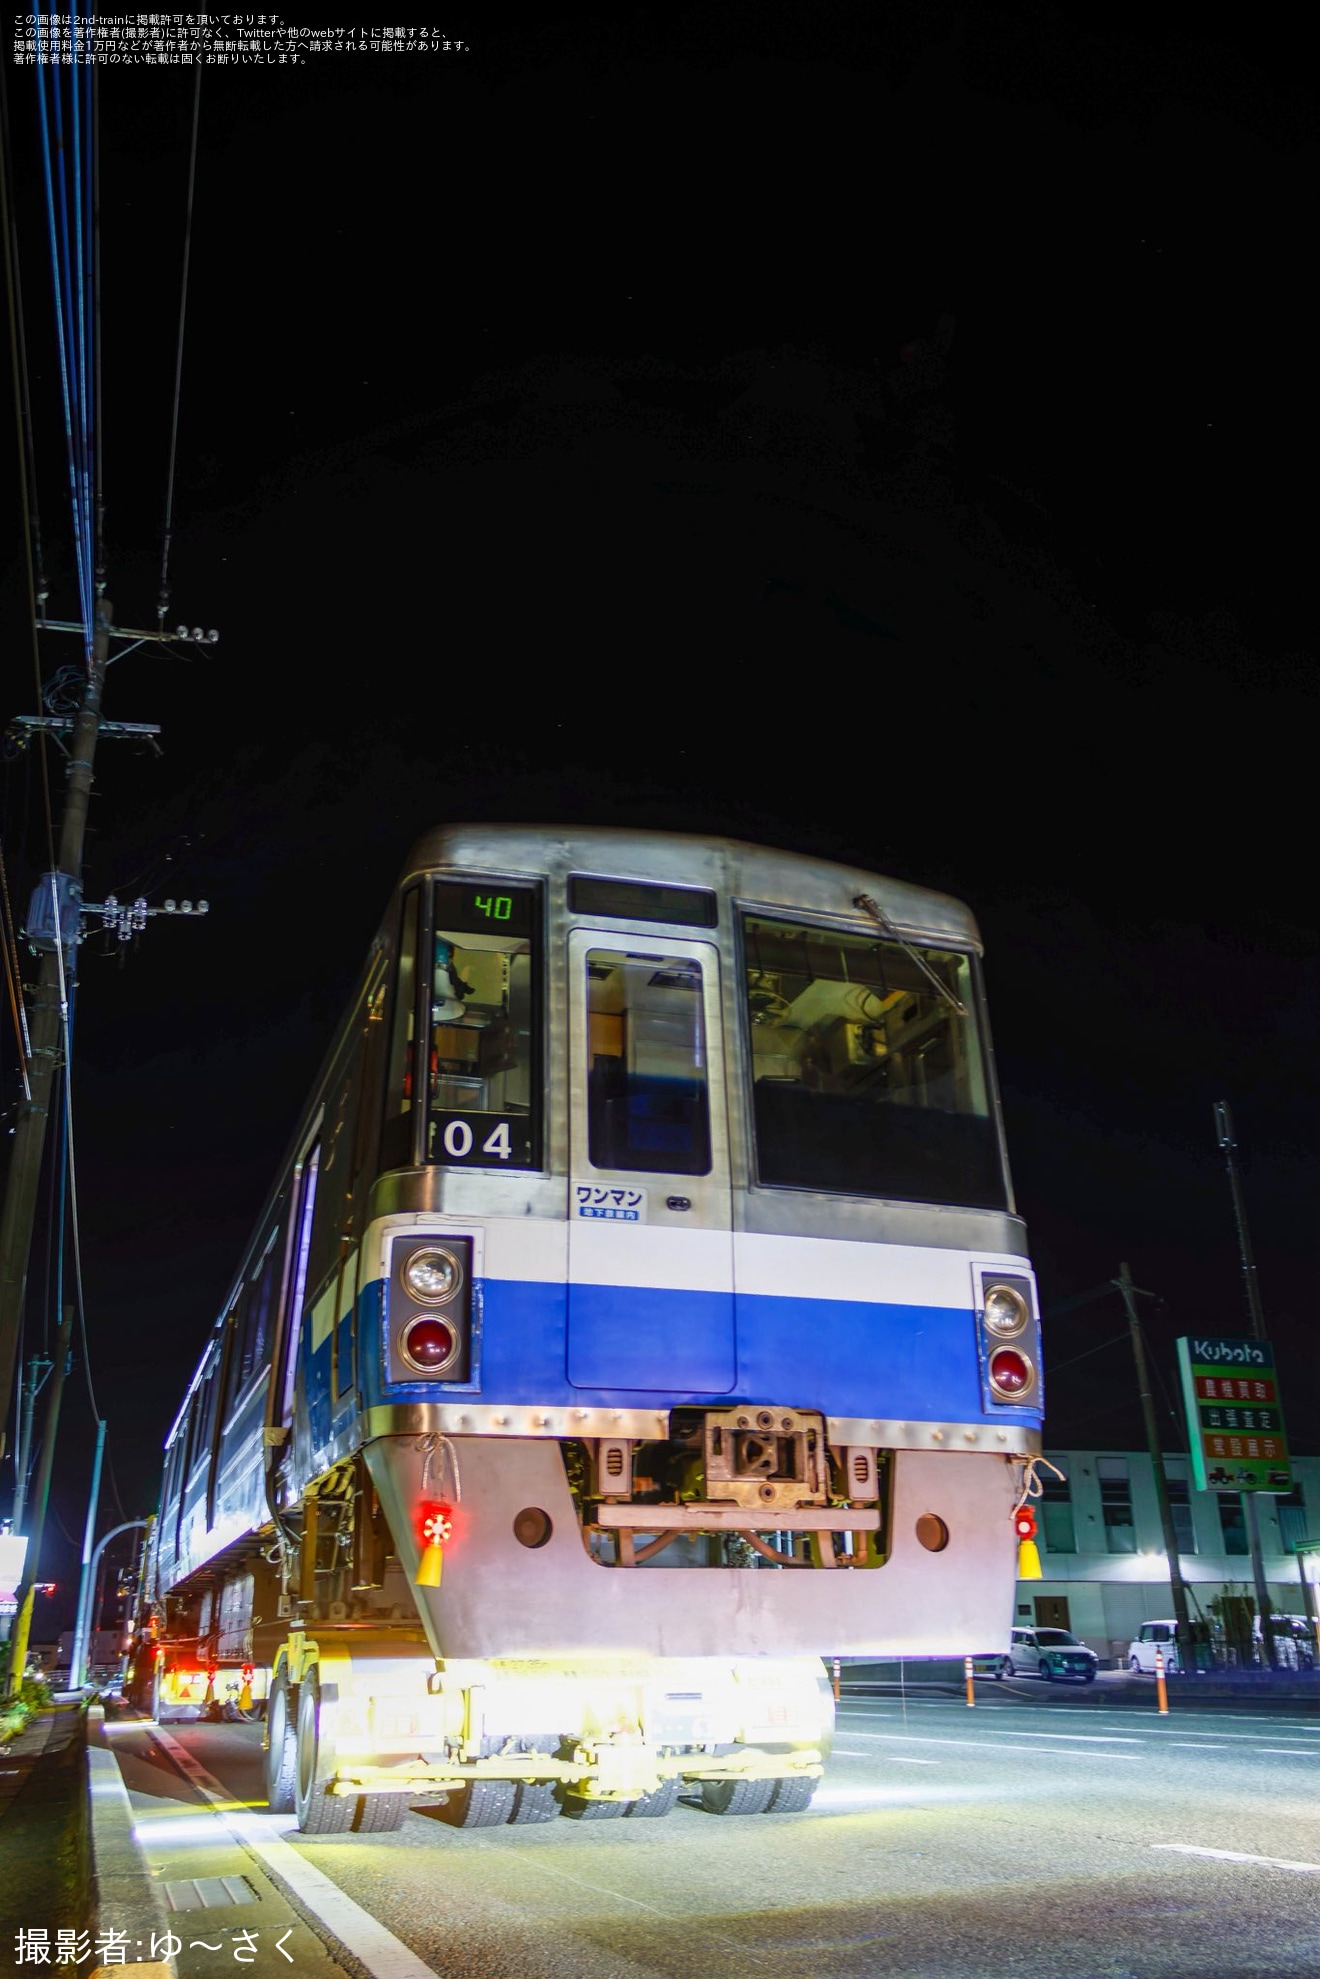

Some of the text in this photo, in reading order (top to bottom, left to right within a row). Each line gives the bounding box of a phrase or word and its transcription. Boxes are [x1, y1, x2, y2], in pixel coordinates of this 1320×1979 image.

[474, 895, 513, 920] 40
[443, 1120, 512, 1160] 04
[576, 1186, 643, 1207] ワンマン
[1193, 1340, 1265, 1363] Kubota
[1205, 1379, 1268, 1399] 農機買取
[1209, 1408, 1272, 1429] 出張査定
